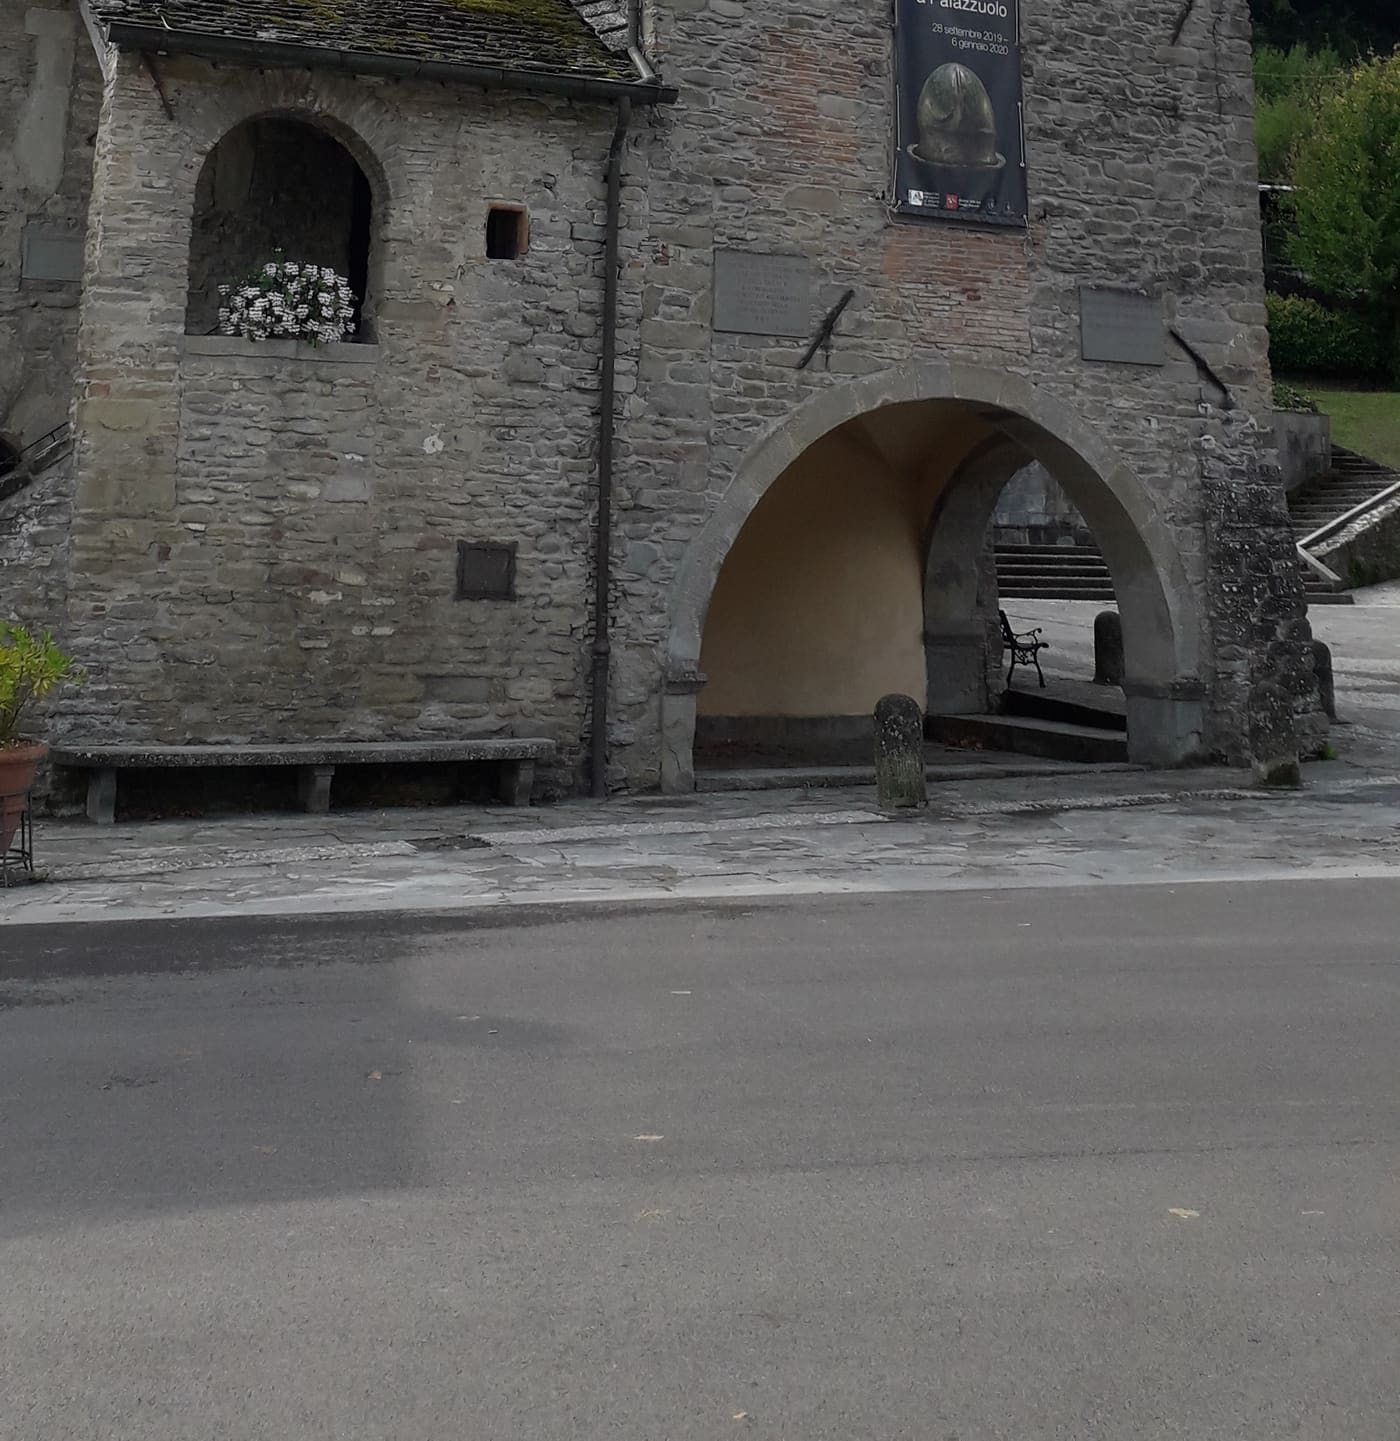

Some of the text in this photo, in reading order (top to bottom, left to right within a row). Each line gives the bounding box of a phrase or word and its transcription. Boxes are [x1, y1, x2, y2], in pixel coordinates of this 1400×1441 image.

[932, 22, 943, 33] 28
[944, 25, 982, 40] settembre
[983, 31, 1002, 43] 2019
[952, 37, 1008, 56] 6 gennaio 2020
